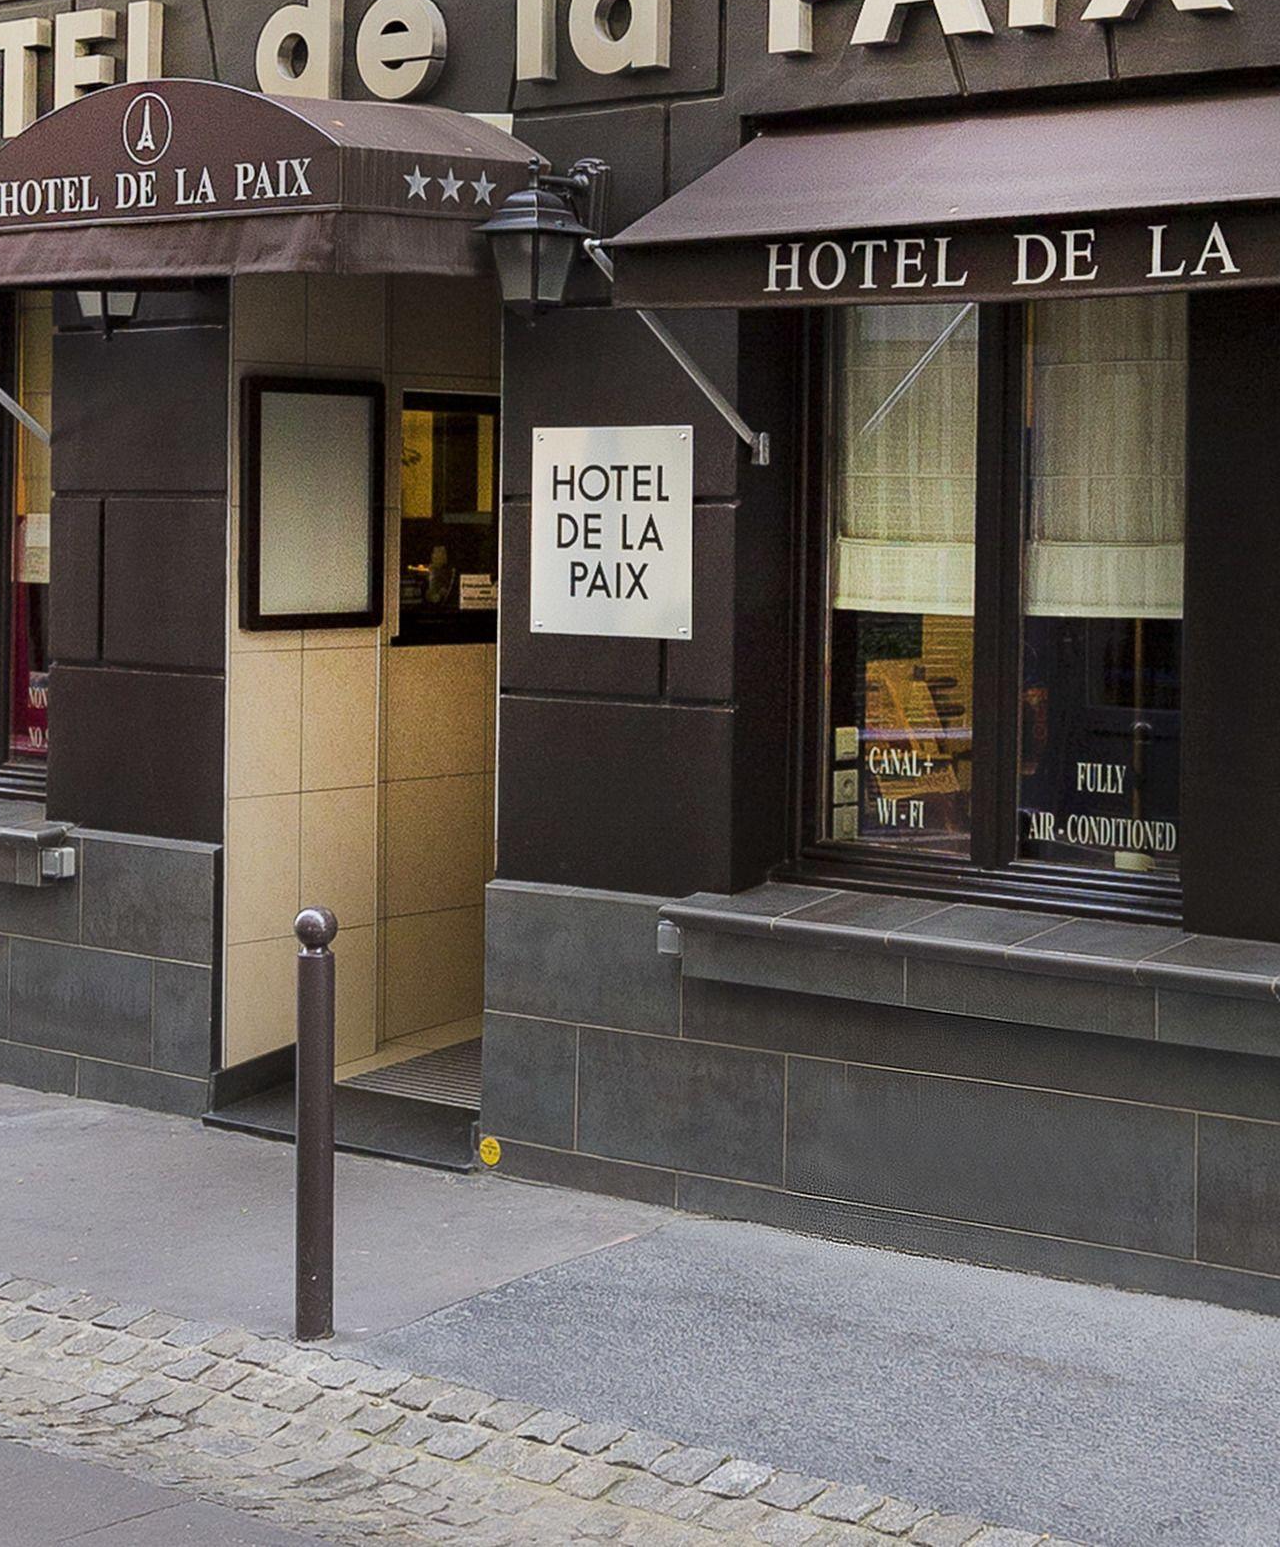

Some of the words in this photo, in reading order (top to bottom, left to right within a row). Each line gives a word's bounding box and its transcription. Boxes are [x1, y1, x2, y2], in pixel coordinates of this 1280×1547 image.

[115, 170, 157, 210] DE
[174, 166, 217, 205] LA
[234, 157, 313, 201] PAIX
[763, 236, 969, 292] HOTEL
[1012, 228, 1099, 285] DE
[1146, 221, 1241, 278] LA
[552, 464, 669, 501] HOTEL
[557, 513, 602, 549] DE
[621, 513, 663, 551] LA
[570, 561, 649, 600] PAIX
[869, 746, 921, 777] CANAL
[1077, 762, 1126, 794] FULLY
